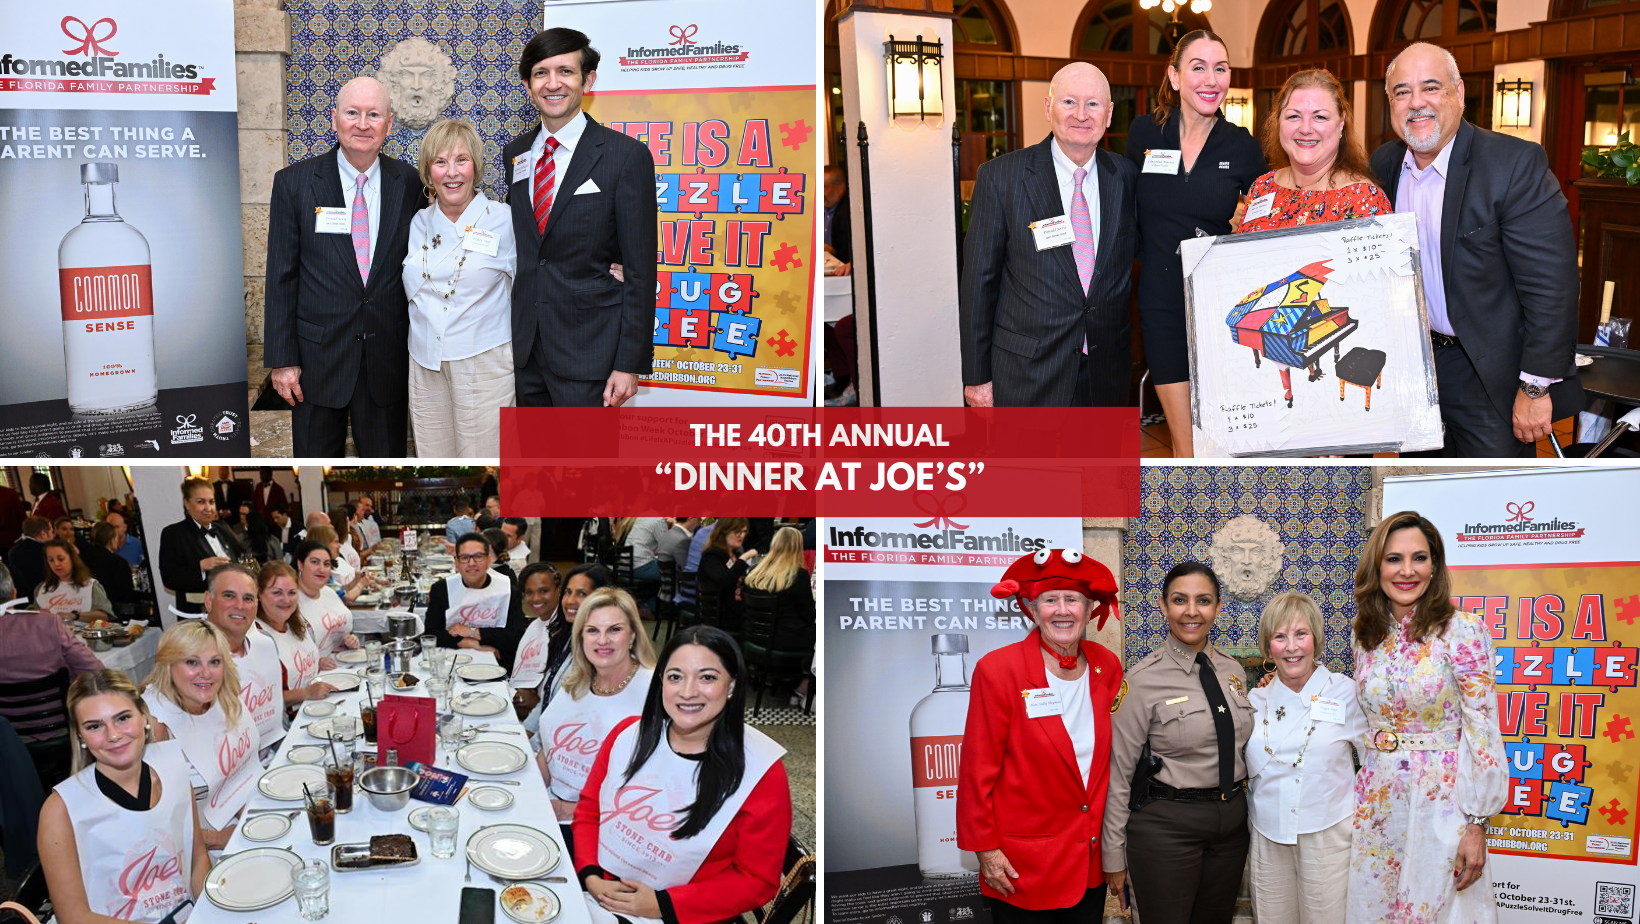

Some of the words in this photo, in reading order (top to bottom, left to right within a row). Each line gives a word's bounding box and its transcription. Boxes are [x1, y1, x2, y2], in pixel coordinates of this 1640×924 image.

[9, 80, 65, 90] FLORIDA
[70, 82, 114, 92] FAMILY
[118, 84, 200, 93] PARTNERSHIP
[0, 126, 42, 140] THE
[50, 126, 102, 140] BEST
[110, 127, 175, 141] THING
[181, 127, 196, 141] A
[682, 119, 730, 167] IS
[737, 119, 773, 167] A
[83, 144, 128, 159] CAN
[135, 144, 207, 159] SERVE.
[724, 220, 772, 268] IT
[74, 273, 140, 312] COMMON
[86, 321, 135, 333] SENSE
[90, 369, 136, 377] HOMEGROWN
[676, 360, 715, 372] OCTOBER
[717, 363, 742, 374] 23-31
[636, 414, 673, 424] support
[674, 416, 688, 425] for
[170, 426, 203, 436] Informed
[641, 425, 665, 435] Week
[832, 552, 856, 561] THE
[861, 553, 916, 562] FLORIDA
[921, 554, 964, 563] FAMILY
[968, 556, 1020, 565] PARTNE
[849, 597, 893, 612] THE
[901, 598, 951, 612] BEST
[459, 602, 498, 625] Joe's
[1517, 594, 1565, 641] IS
[1571, 594, 1607, 641] A
[839, 616, 926, 630] PARENT
[934, 616, 978, 630] CAN
[1558, 692, 1605, 739] IT
[211, 727, 250, 808] Joe's
[936, 789, 957, 800] SE
[1509, 827, 1548, 839] OCTOBER
[1549, 830, 1574, 841] 23-31
[615, 820, 644, 844] STONE
[646, 842, 673, 863] CRAB
[622, 838, 640, 852] SINCE
[1507, 882, 1520, 890] for
[144, 891, 170, 908] STONE
[1500, 892, 1536, 902] October
[1538, 896, 1575, 907] 23-31st.
